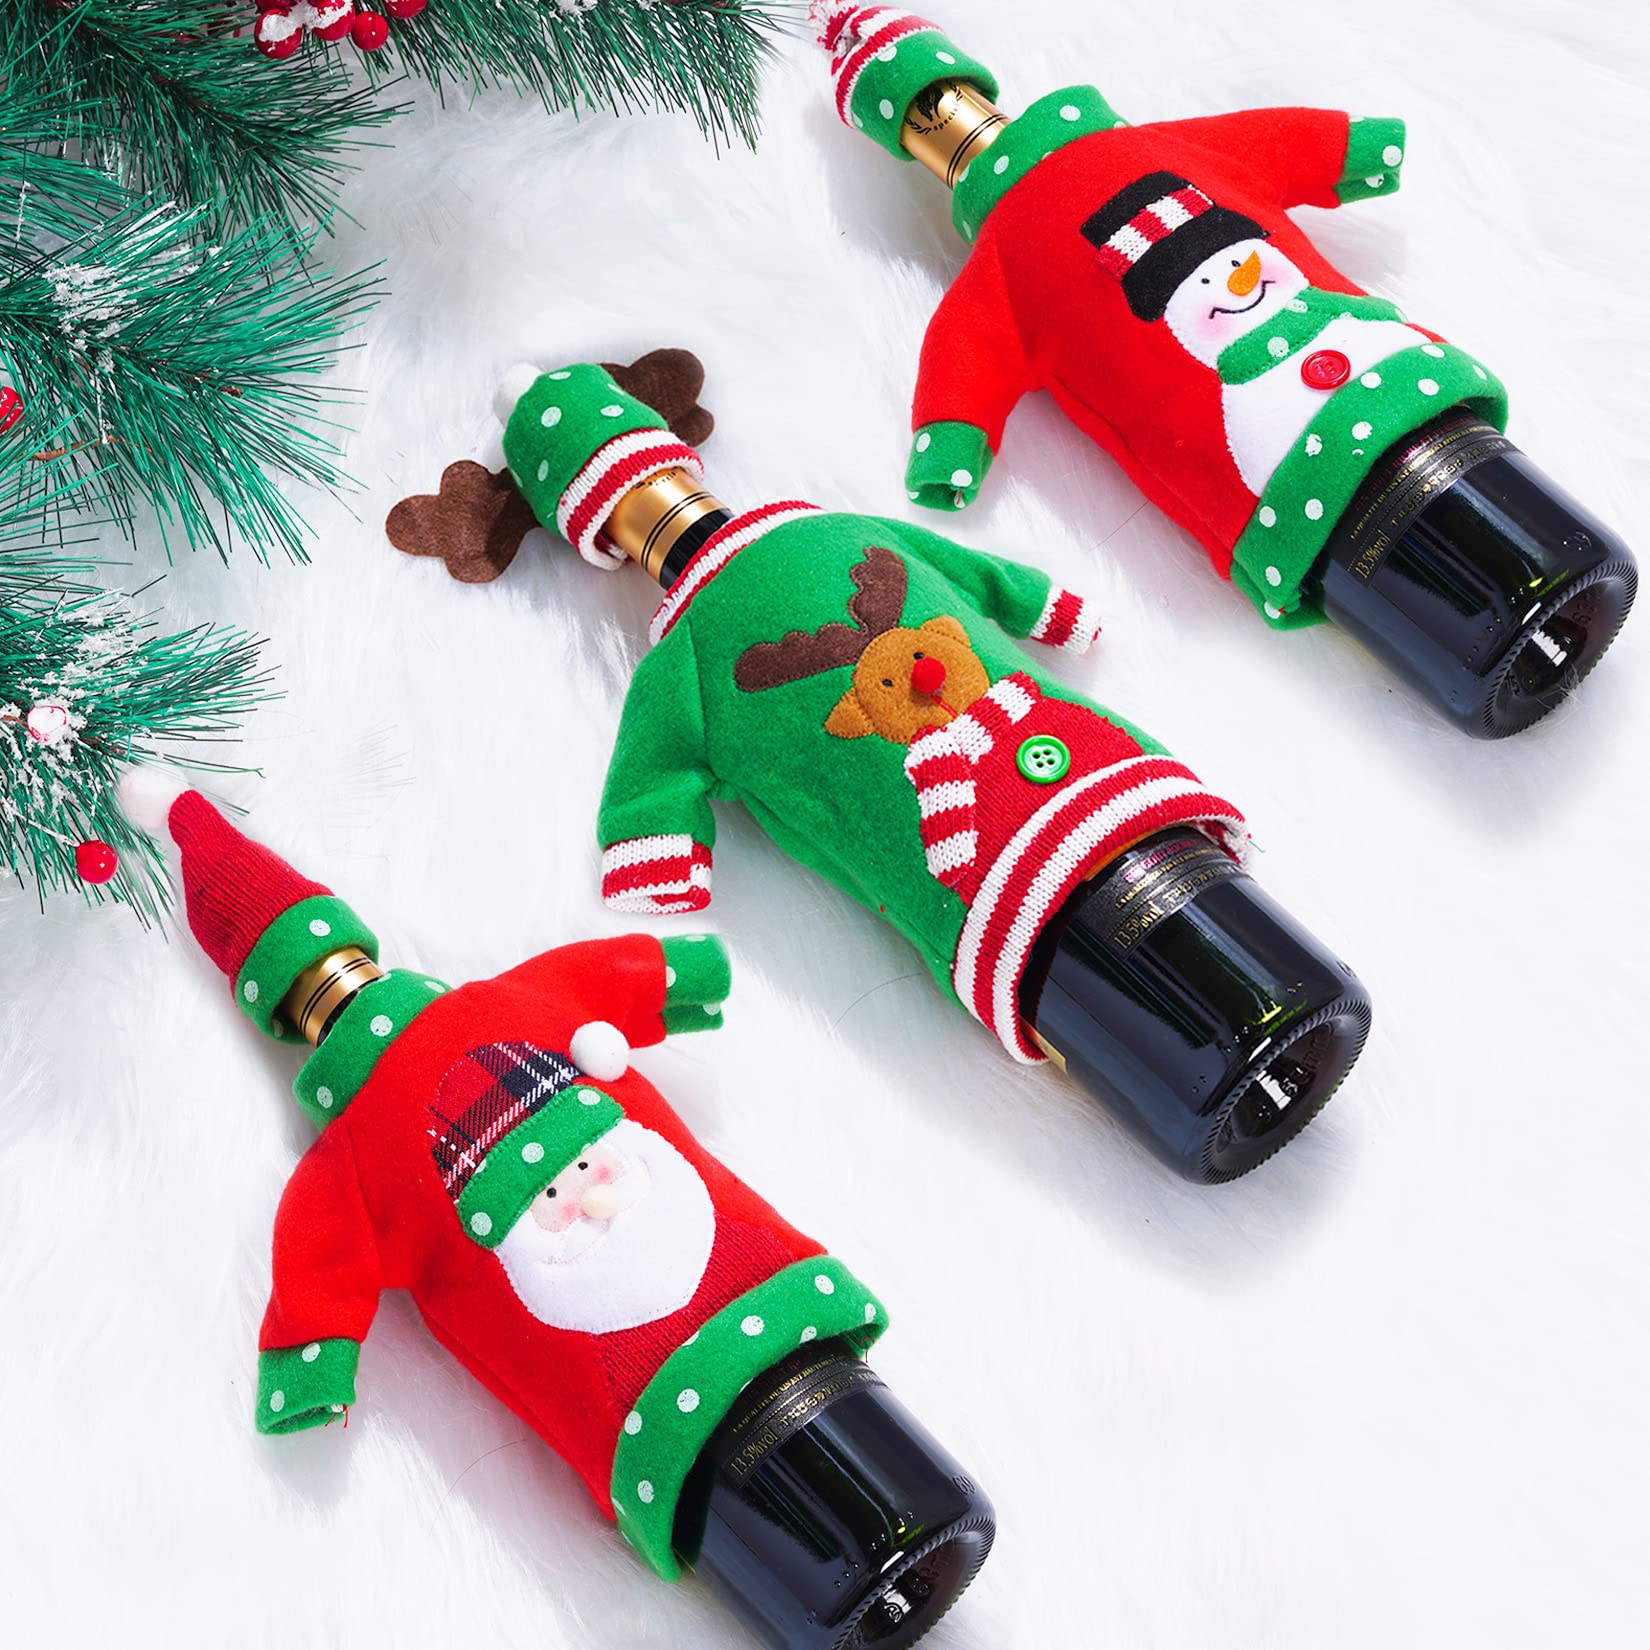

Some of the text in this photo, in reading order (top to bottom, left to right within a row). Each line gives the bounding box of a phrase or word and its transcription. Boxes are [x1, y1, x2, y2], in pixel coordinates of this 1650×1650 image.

[1356, 529, 1390, 579] 13.5%vol
[1114, 900, 1162, 949] 13.5%vol
[731, 1427, 778, 1476] 13.5%vol
